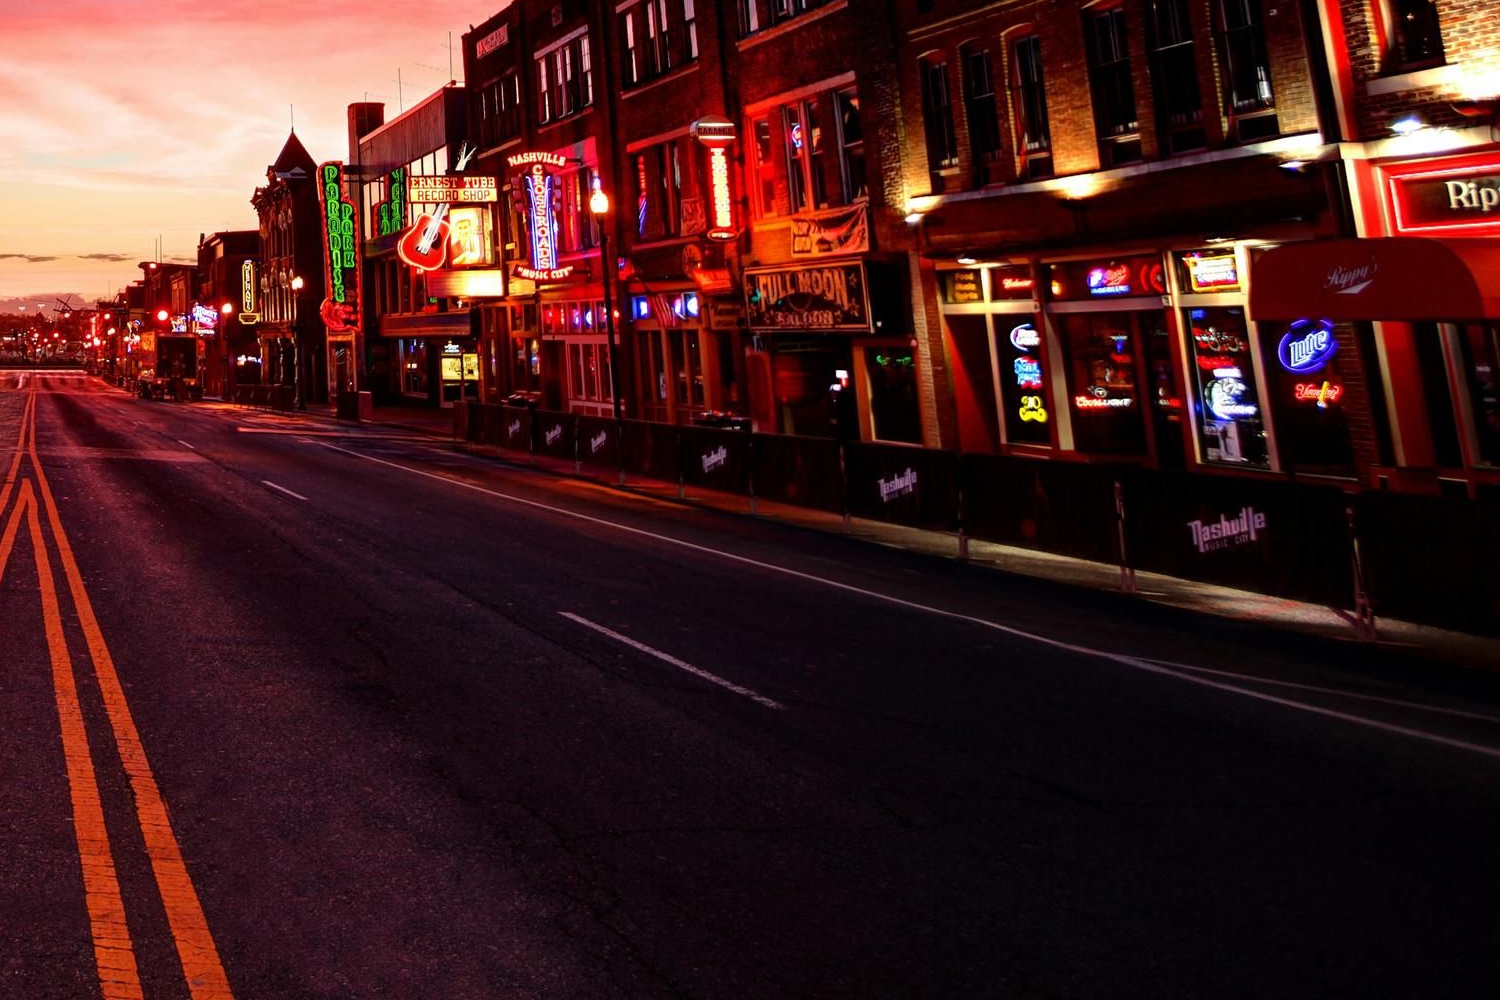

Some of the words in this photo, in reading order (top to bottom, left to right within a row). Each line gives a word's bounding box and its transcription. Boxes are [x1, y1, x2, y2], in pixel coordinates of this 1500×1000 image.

[508, 152, 566, 167] NASHVILLE
[410, 177, 458, 188] ERNEST
[463, 177, 496, 188] TUBB
[417, 190, 459, 201] RECORD
[463, 190, 491, 201] SHOP
[1445, 181, 1500, 212] Rip
[324, 165, 345, 303] PARADISE
[341, 203, 355, 268] PARK
[532, 165, 551, 269] CROSSROADS
[759, 271, 795, 312] FULL
[795, 268, 850, 311] MOON
[775, 311, 834, 326] SALOON
[1289, 330, 1328, 367] Lite
[1186, 506, 1266, 553] Nashville
